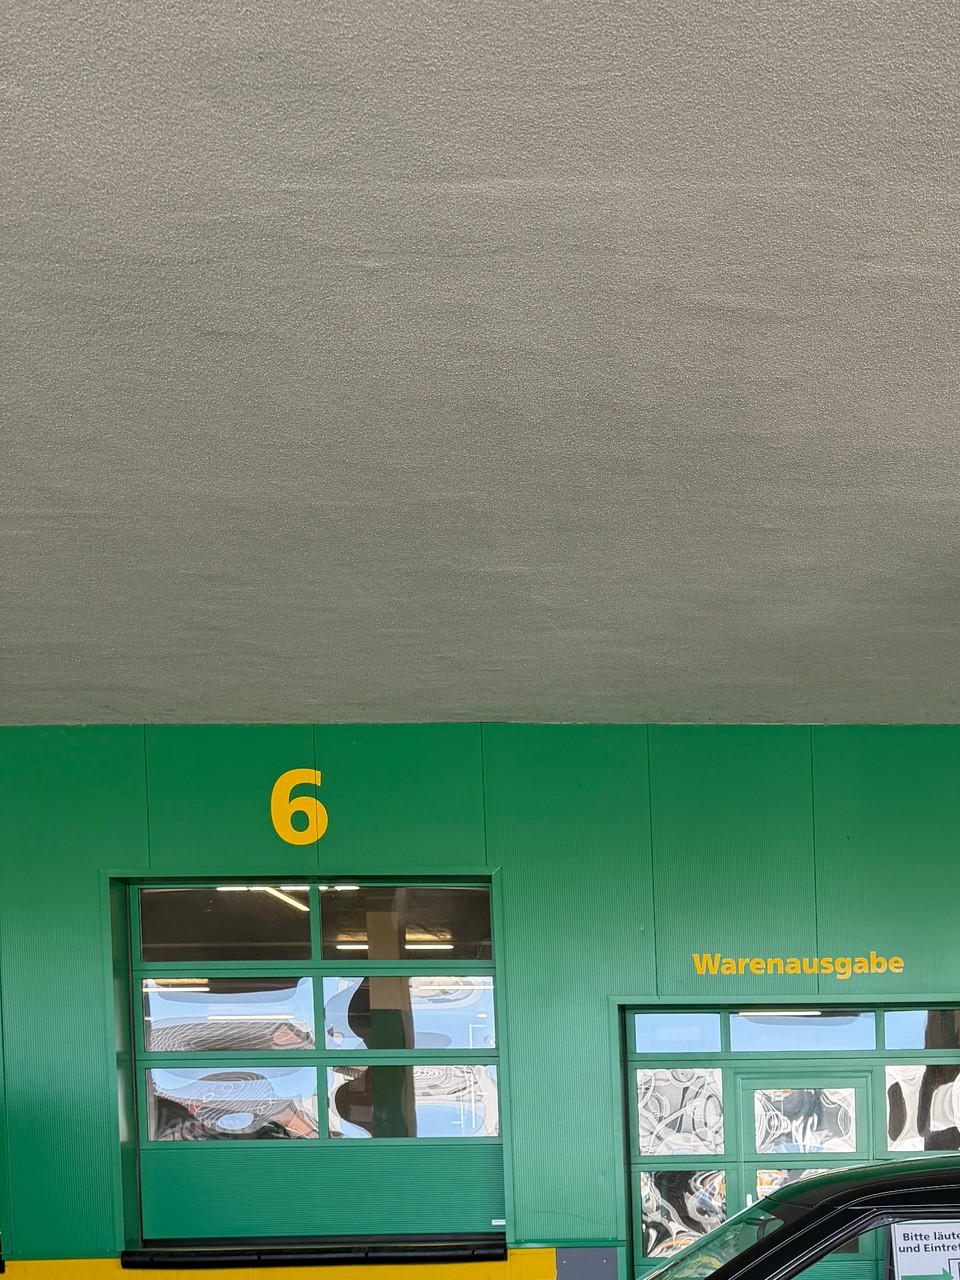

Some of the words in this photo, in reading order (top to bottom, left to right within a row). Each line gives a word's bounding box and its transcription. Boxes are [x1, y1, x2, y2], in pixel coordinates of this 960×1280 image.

[270, 768, 328, 846] 6
[692, 951, 905, 980] Warenausgabe
[902, 1232, 930, 1241] Bitte
[898, 1244, 920, 1253] und
